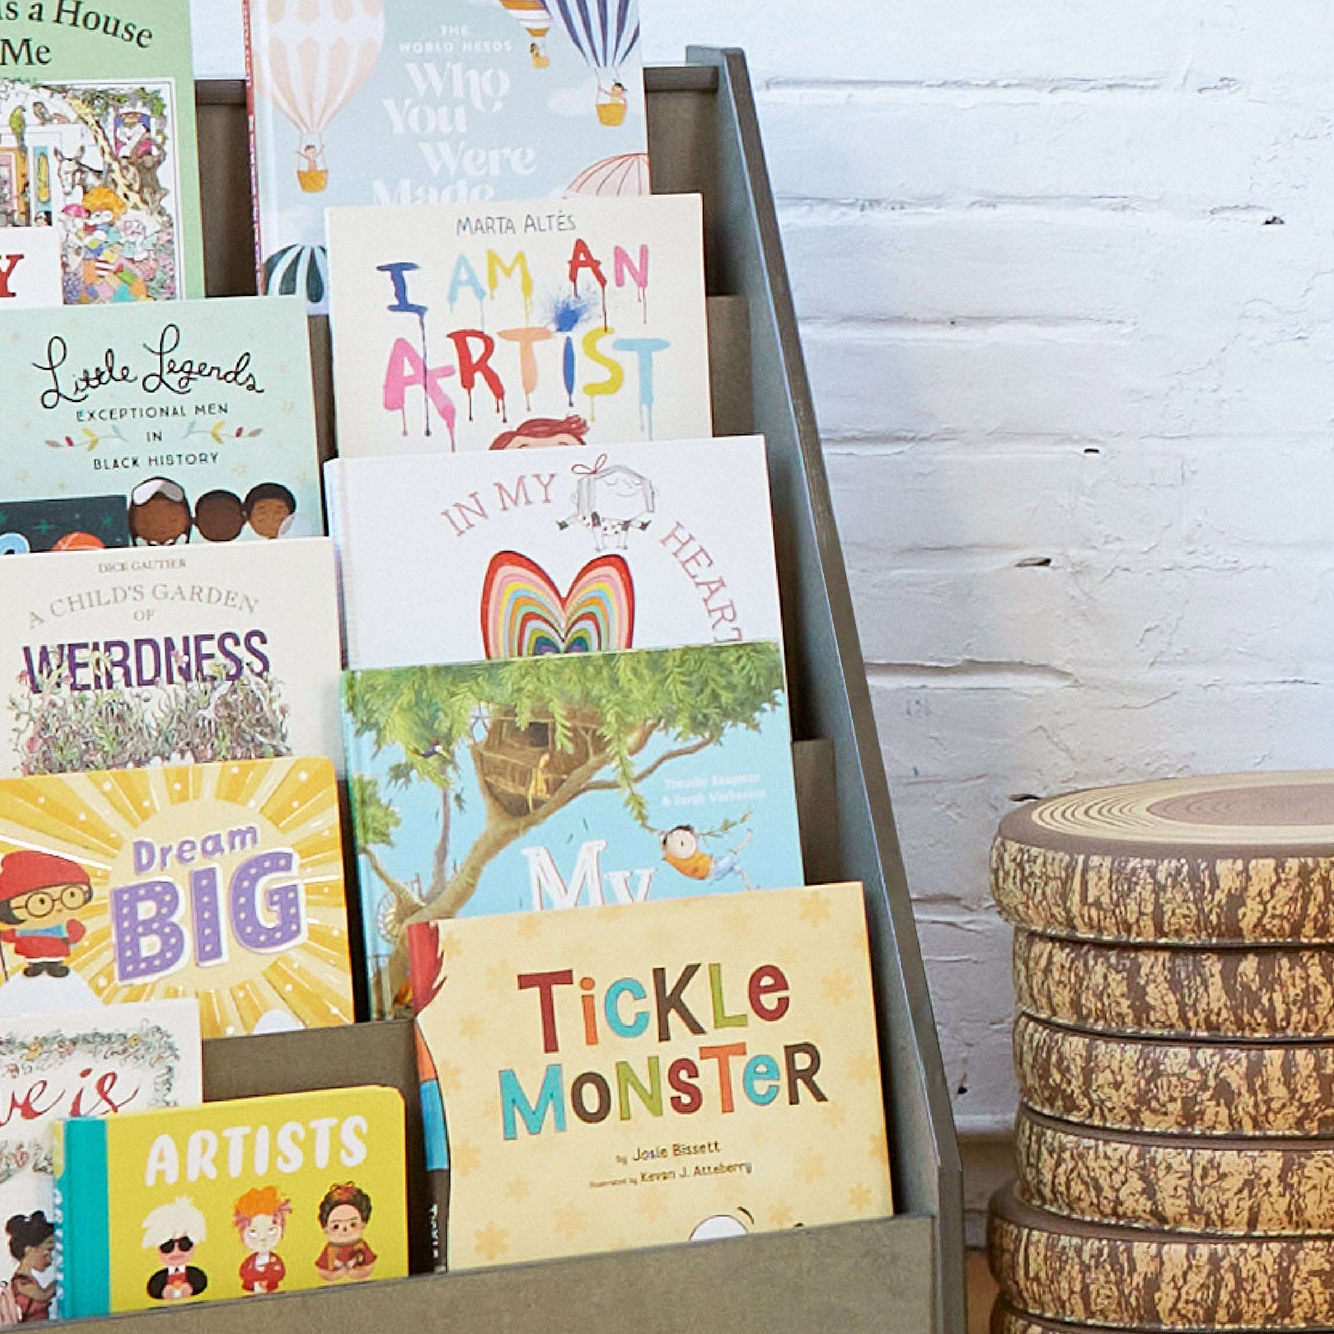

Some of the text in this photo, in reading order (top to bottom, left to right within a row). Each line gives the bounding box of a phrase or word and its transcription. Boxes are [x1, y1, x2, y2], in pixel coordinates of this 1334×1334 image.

[28, 2, 44, 23] a
[440, 24, 469, 36] THE
[0, 38, 52, 66] Me
[399, 40, 513, 54] WORLD NEEDS
[405, 61, 511, 113] Who
[382, 98, 468, 135] You
[418, 140, 537, 177] Were
[456, 209, 576, 236] MARTA ALTÉS
[376, 237, 650, 315] I AM AN
[32, 323, 265, 409] Little Legends
[382, 325, 671, 422] ARTIST
[76, 403, 229, 423] EXCEPTIONAL MEN
[146, 431, 163, 443] IN
[93, 452, 219, 471] BLACK HISTORY
[440, 490, 489, 538] IN
[492, 473, 557, 513] MY
[28, 583, 260, 629] A CHILD'S GARDEN
[133, 609, 155, 622] OF
[22, 629, 271, 695] WEIRDNESS
[133, 823, 259, 876] Dream
[109, 848, 308, 986] BIG
[70, 1068, 139, 1117] is
[144, 1114, 369, 1187] ARTISTS
[633, 1147, 667, 1161] Josie
[672, 1141, 720, 1157] Bissett
